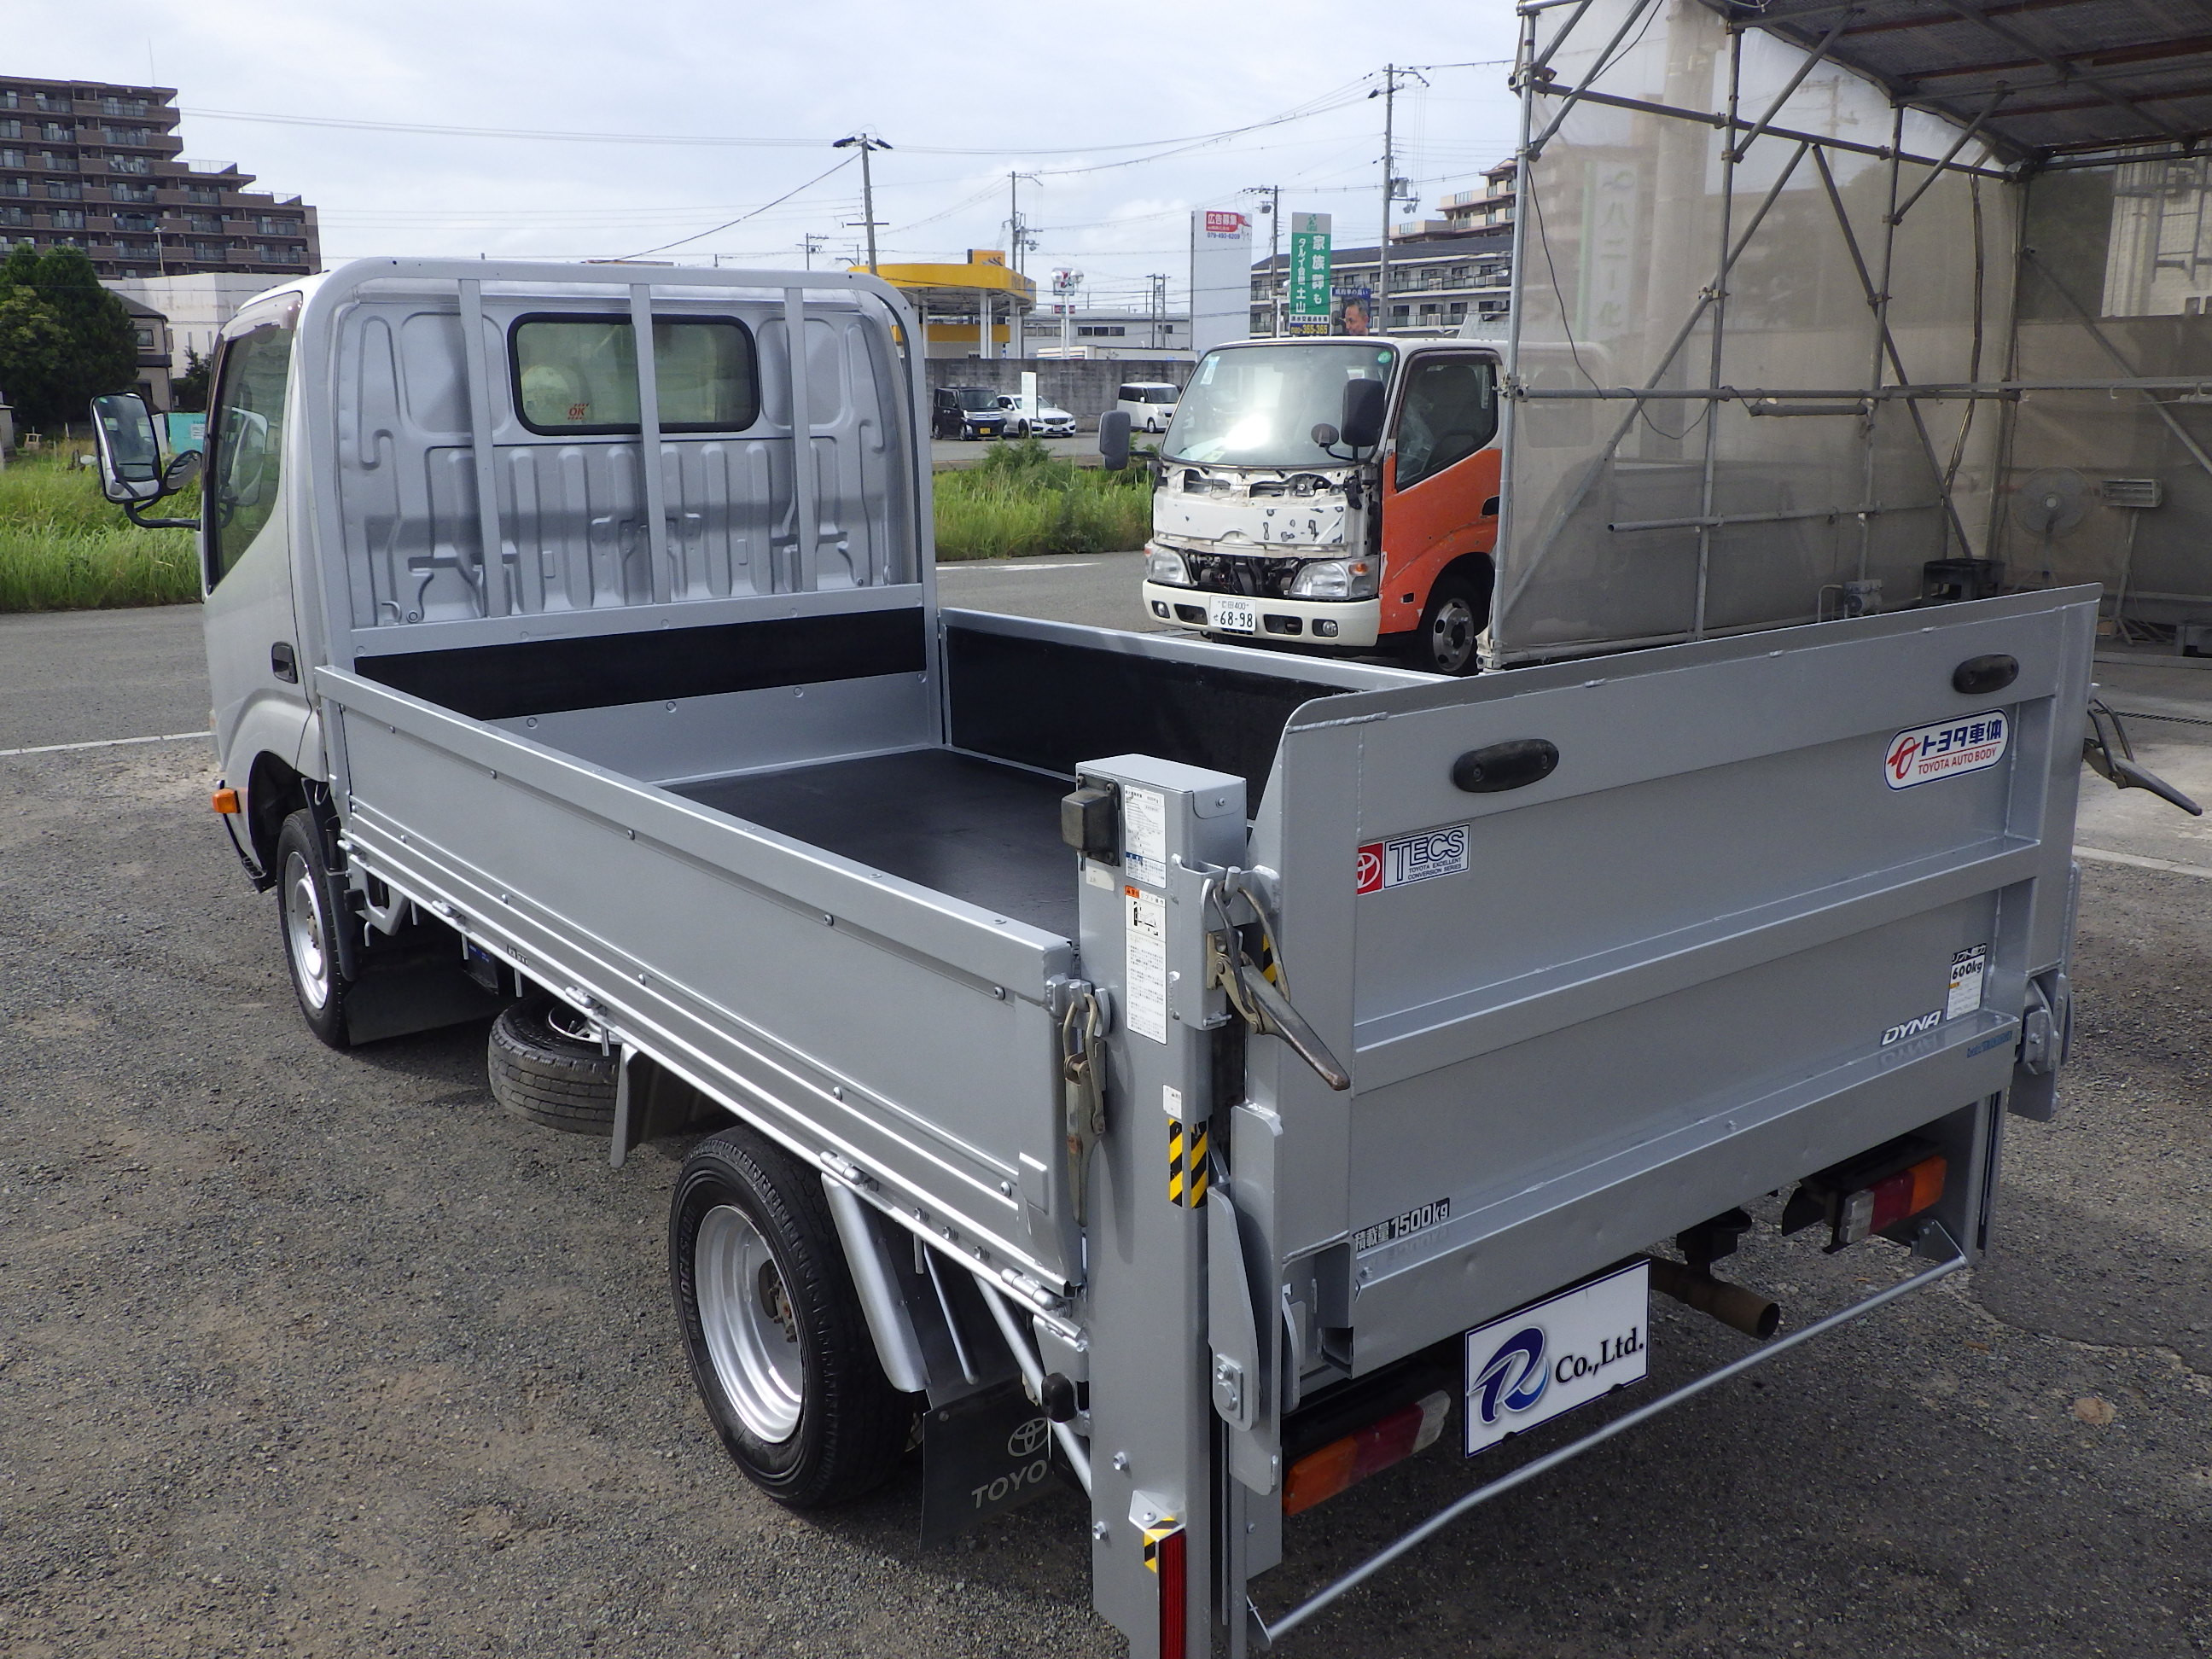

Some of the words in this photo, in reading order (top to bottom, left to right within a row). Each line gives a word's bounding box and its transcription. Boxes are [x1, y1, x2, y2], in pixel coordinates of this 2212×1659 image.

[1220, 610, 1253, 628] 68-98
[1921, 719, 2003, 757] トヨタ車体
[1918, 759, 1949, 775] TOYOTA
[1951, 752, 1974, 766] AUTO
[1975, 747, 1998, 762] BODY
[1389, 830, 1464, 882] TECS
[1407, 868, 1442, 881] CONVERSION
[1443, 863, 1462, 874] SERIES
[1408, 864, 1430, 874] TOYOTA
[1432, 857, 1462, 869] EXCELLENT
[1952, 960, 1983, 981] 600kg
[1881, 1010, 1942, 1046] DYNA
[1354, 1221, 1389, 1252] 積載量
[1391, 1202, 1448, 1238] 1500kg
[1555, 1327, 1644, 1384] Co.,Ltd.
[971, 1458, 1048, 1510] TOYO
